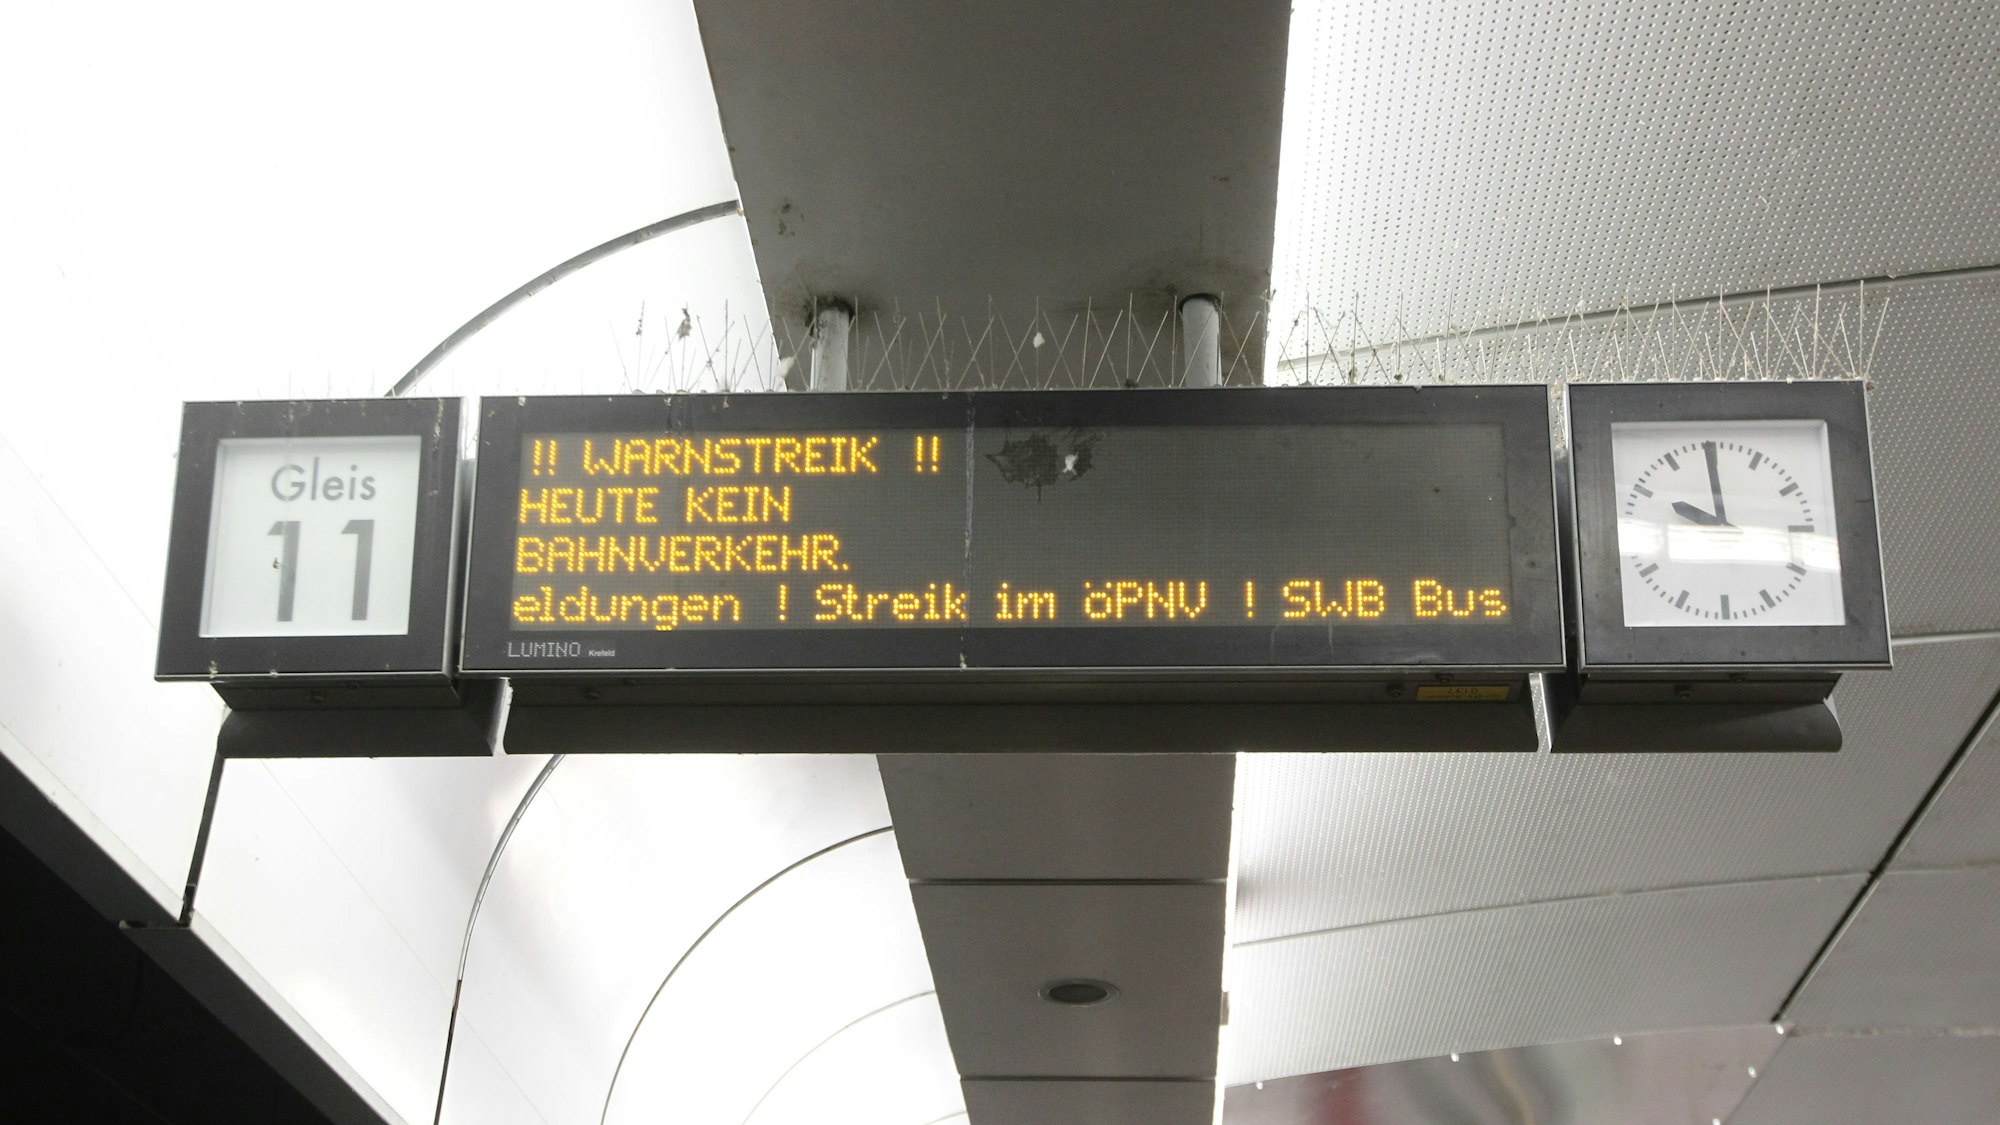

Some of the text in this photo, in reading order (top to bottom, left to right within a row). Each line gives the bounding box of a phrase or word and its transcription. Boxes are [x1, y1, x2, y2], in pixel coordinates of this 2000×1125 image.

[532, 435, 941, 477] !! WARNSTREIK !!
[272, 456, 376, 502] Gleis
[518, 484, 793, 525] HEUTE KEIN
[267, 519, 375, 622] 11
[515, 533, 850, 575] BAHNVERKEHR.
[511, 585, 742, 631] eldungen
[777, 583, 789, 622] !
[814, 582, 969, 623] Streik
[995, 581, 1057, 622] im
[1244, 580, 1256, 619] !
[1280, 577, 1387, 620] SWB
[1411, 577, 1508, 618] Bus
[507, 641, 616, 657] LUMINO Krefeld
